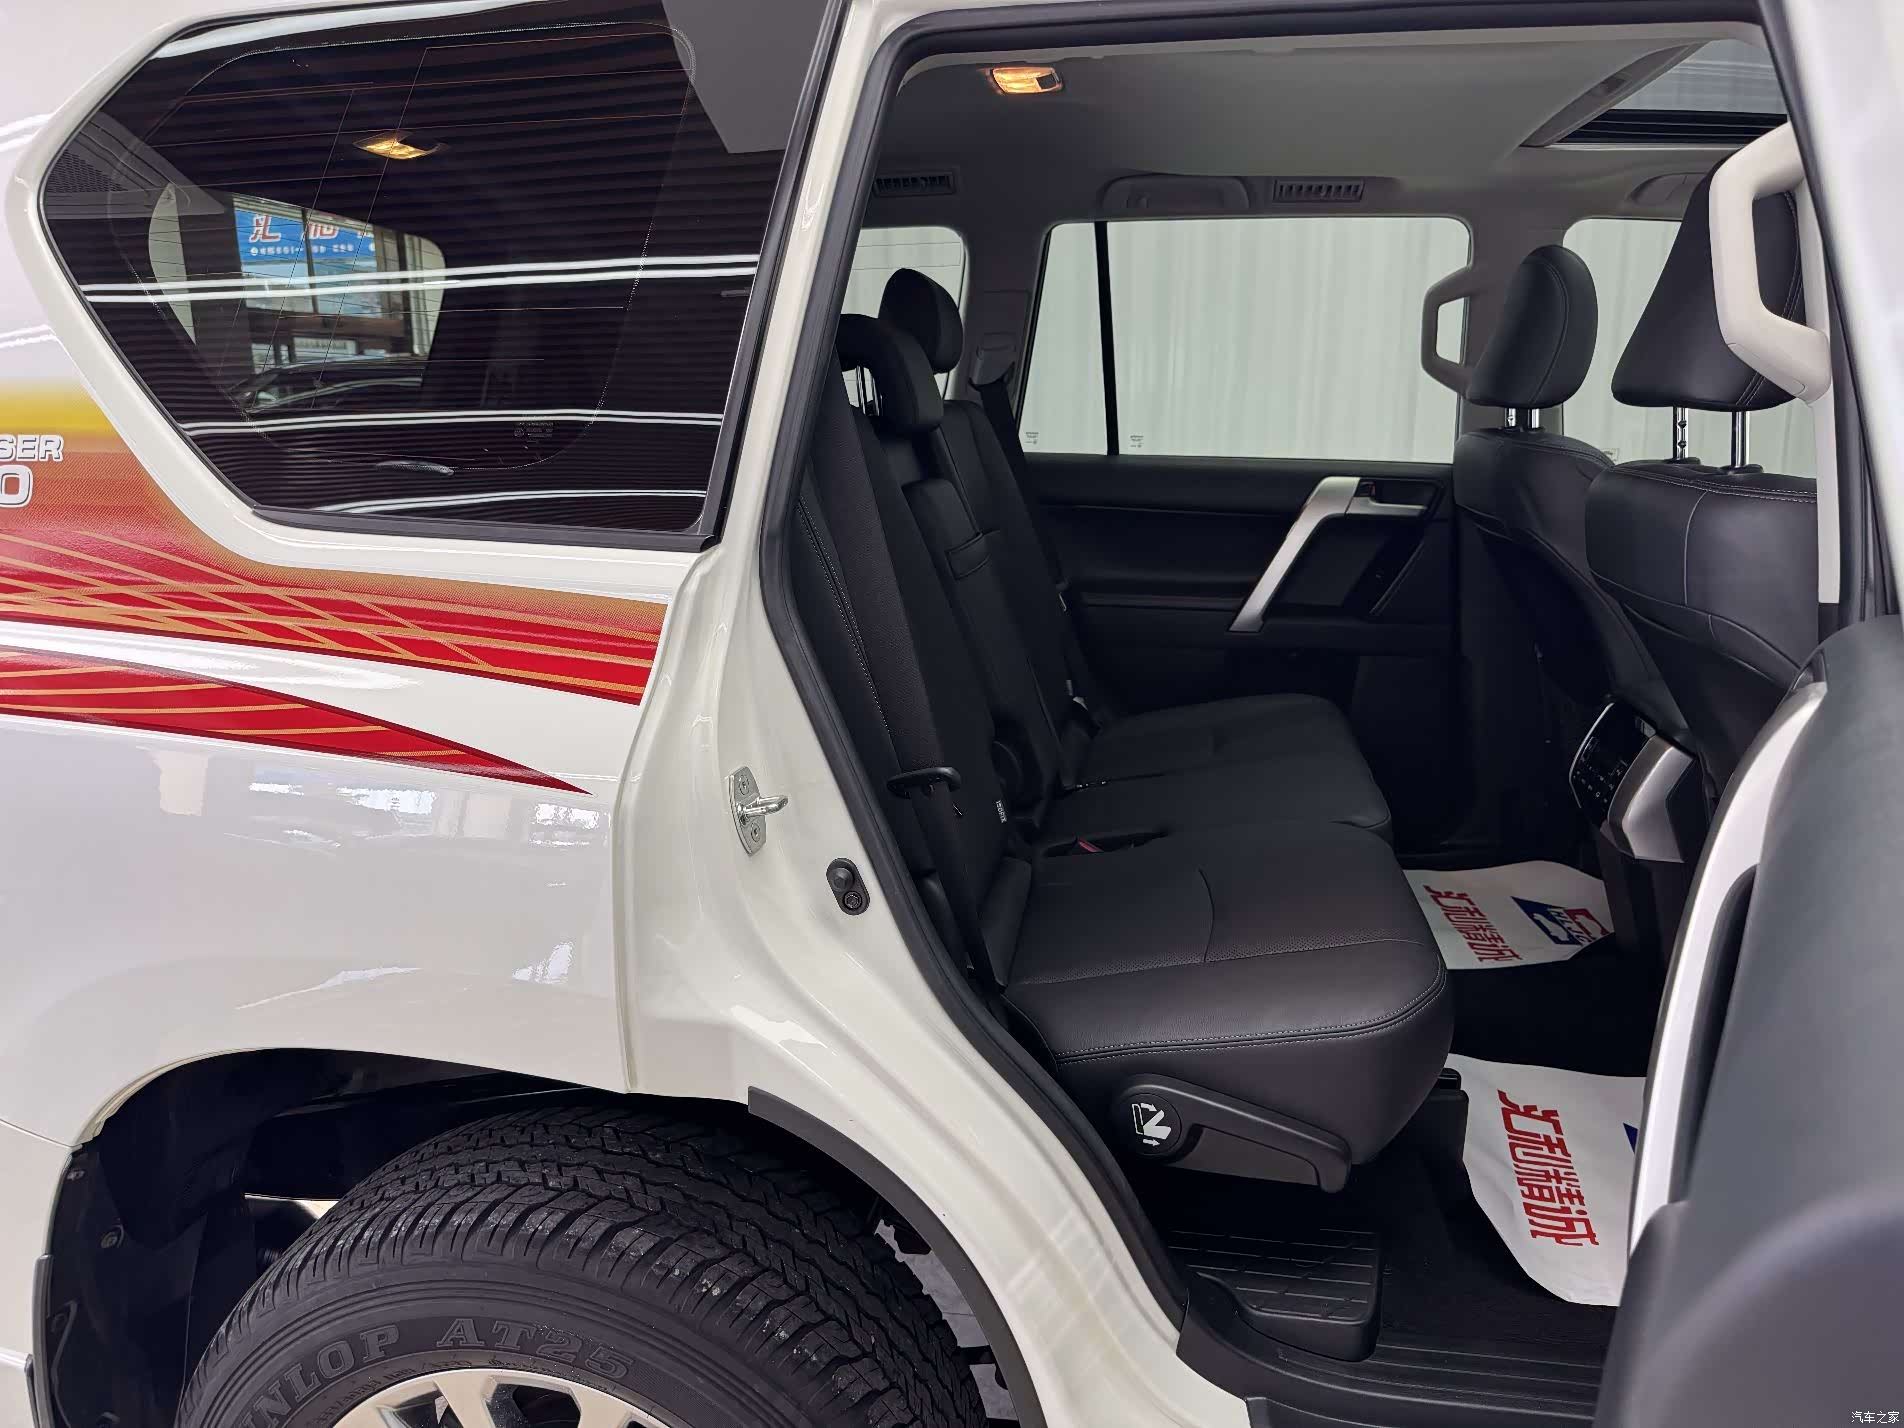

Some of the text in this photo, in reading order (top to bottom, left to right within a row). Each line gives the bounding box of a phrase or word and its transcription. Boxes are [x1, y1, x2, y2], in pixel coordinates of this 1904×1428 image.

[1423, 884, 1524, 963] 汇利精诚
[1496, 1089, 1600, 1248] 汇利精诚
[236, 1323, 401, 1428] NLOP
[435, 1317, 634, 1380] AT25
